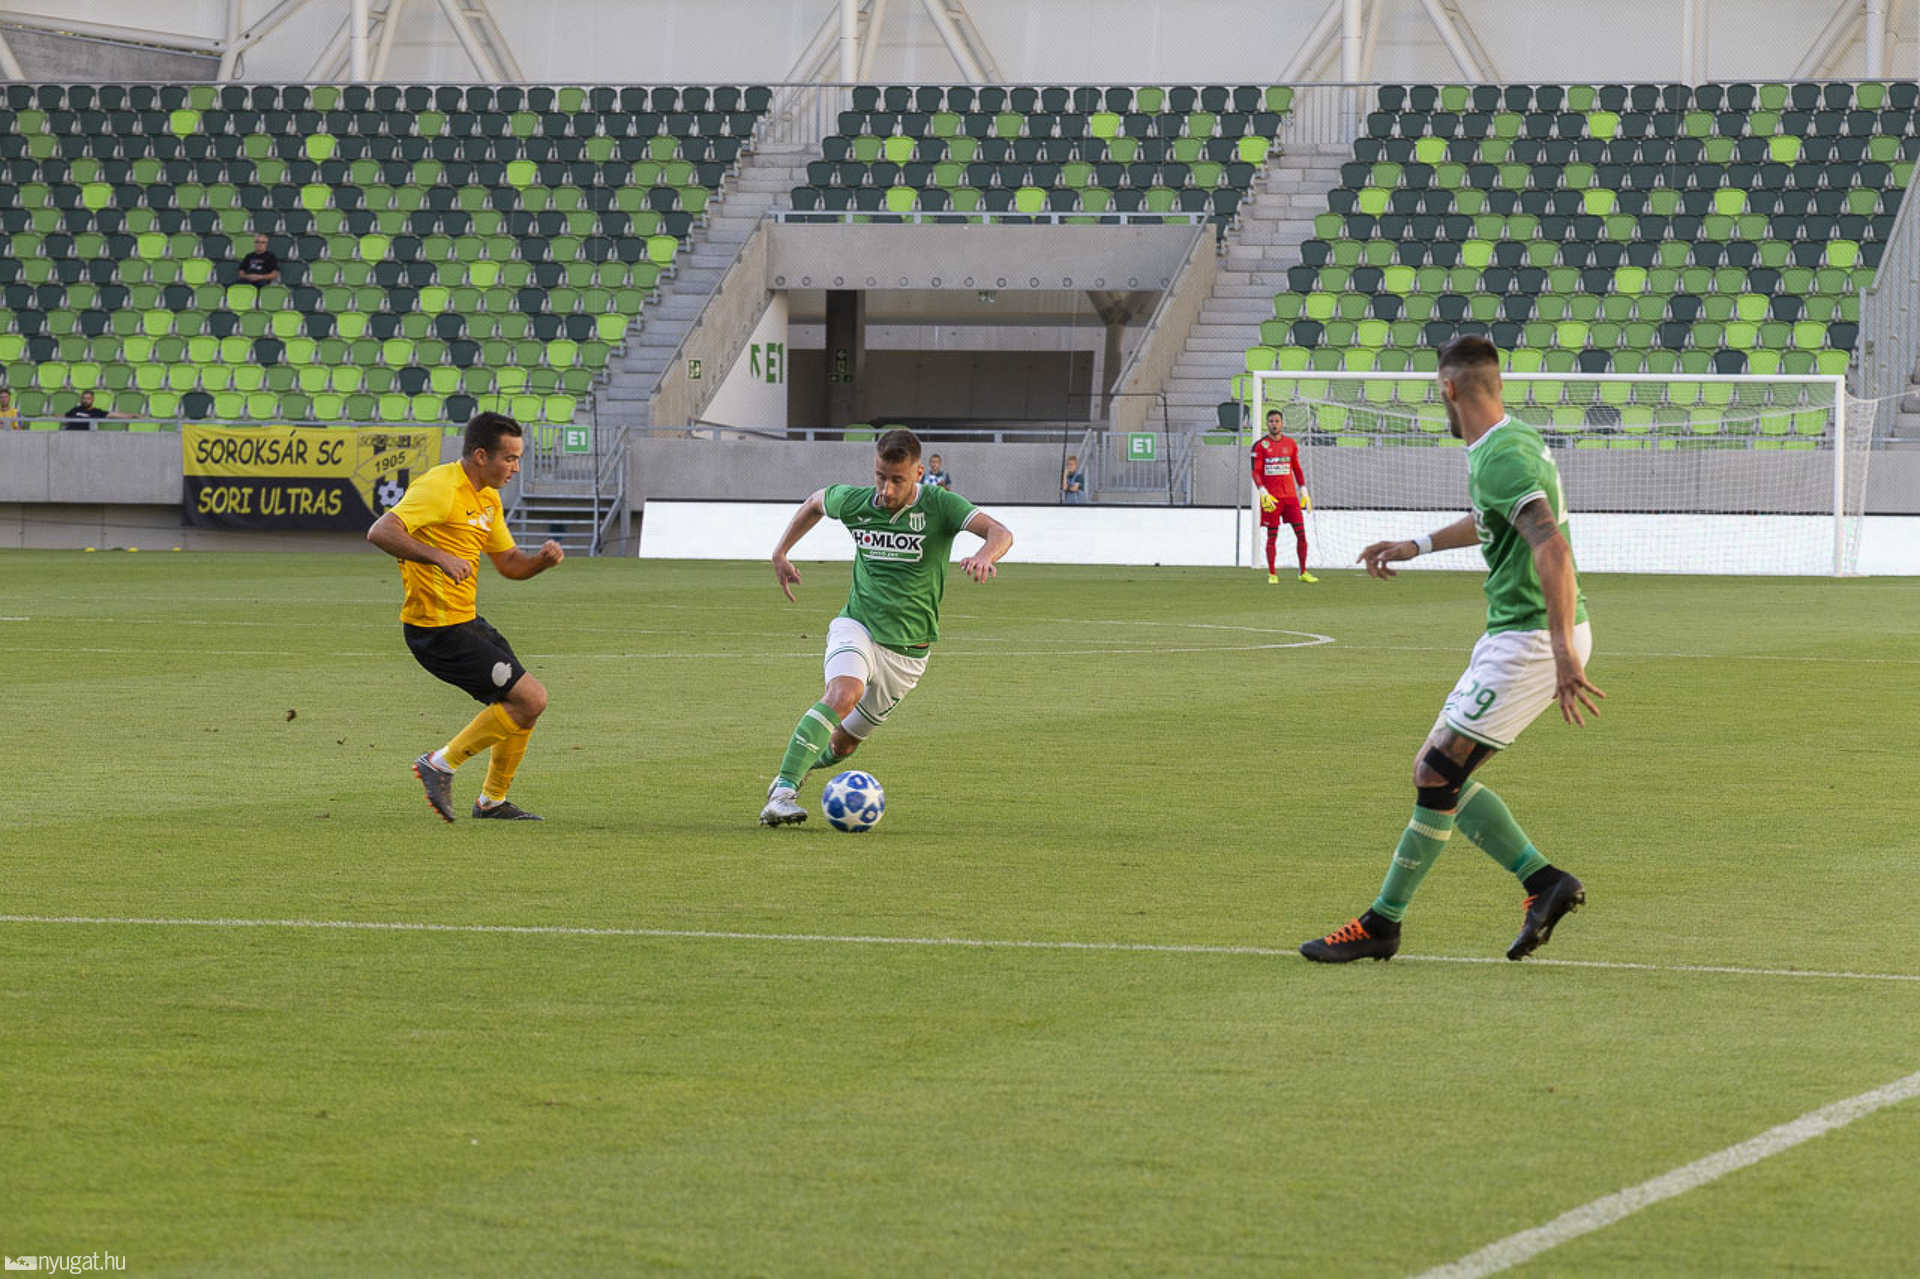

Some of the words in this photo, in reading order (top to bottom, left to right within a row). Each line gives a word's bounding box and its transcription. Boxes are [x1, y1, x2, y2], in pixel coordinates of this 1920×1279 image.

[766, 342, 784, 384] E1
[196, 430, 308, 466] SOROKSÁR
[316, 439, 344, 466] SC
[567, 431, 586, 446] E1
[1133, 438, 1152, 453] E1
[375, 451, 406, 473] 1905
[197, 486, 254, 514] SORI
[260, 487, 343, 516] ULTRAS
